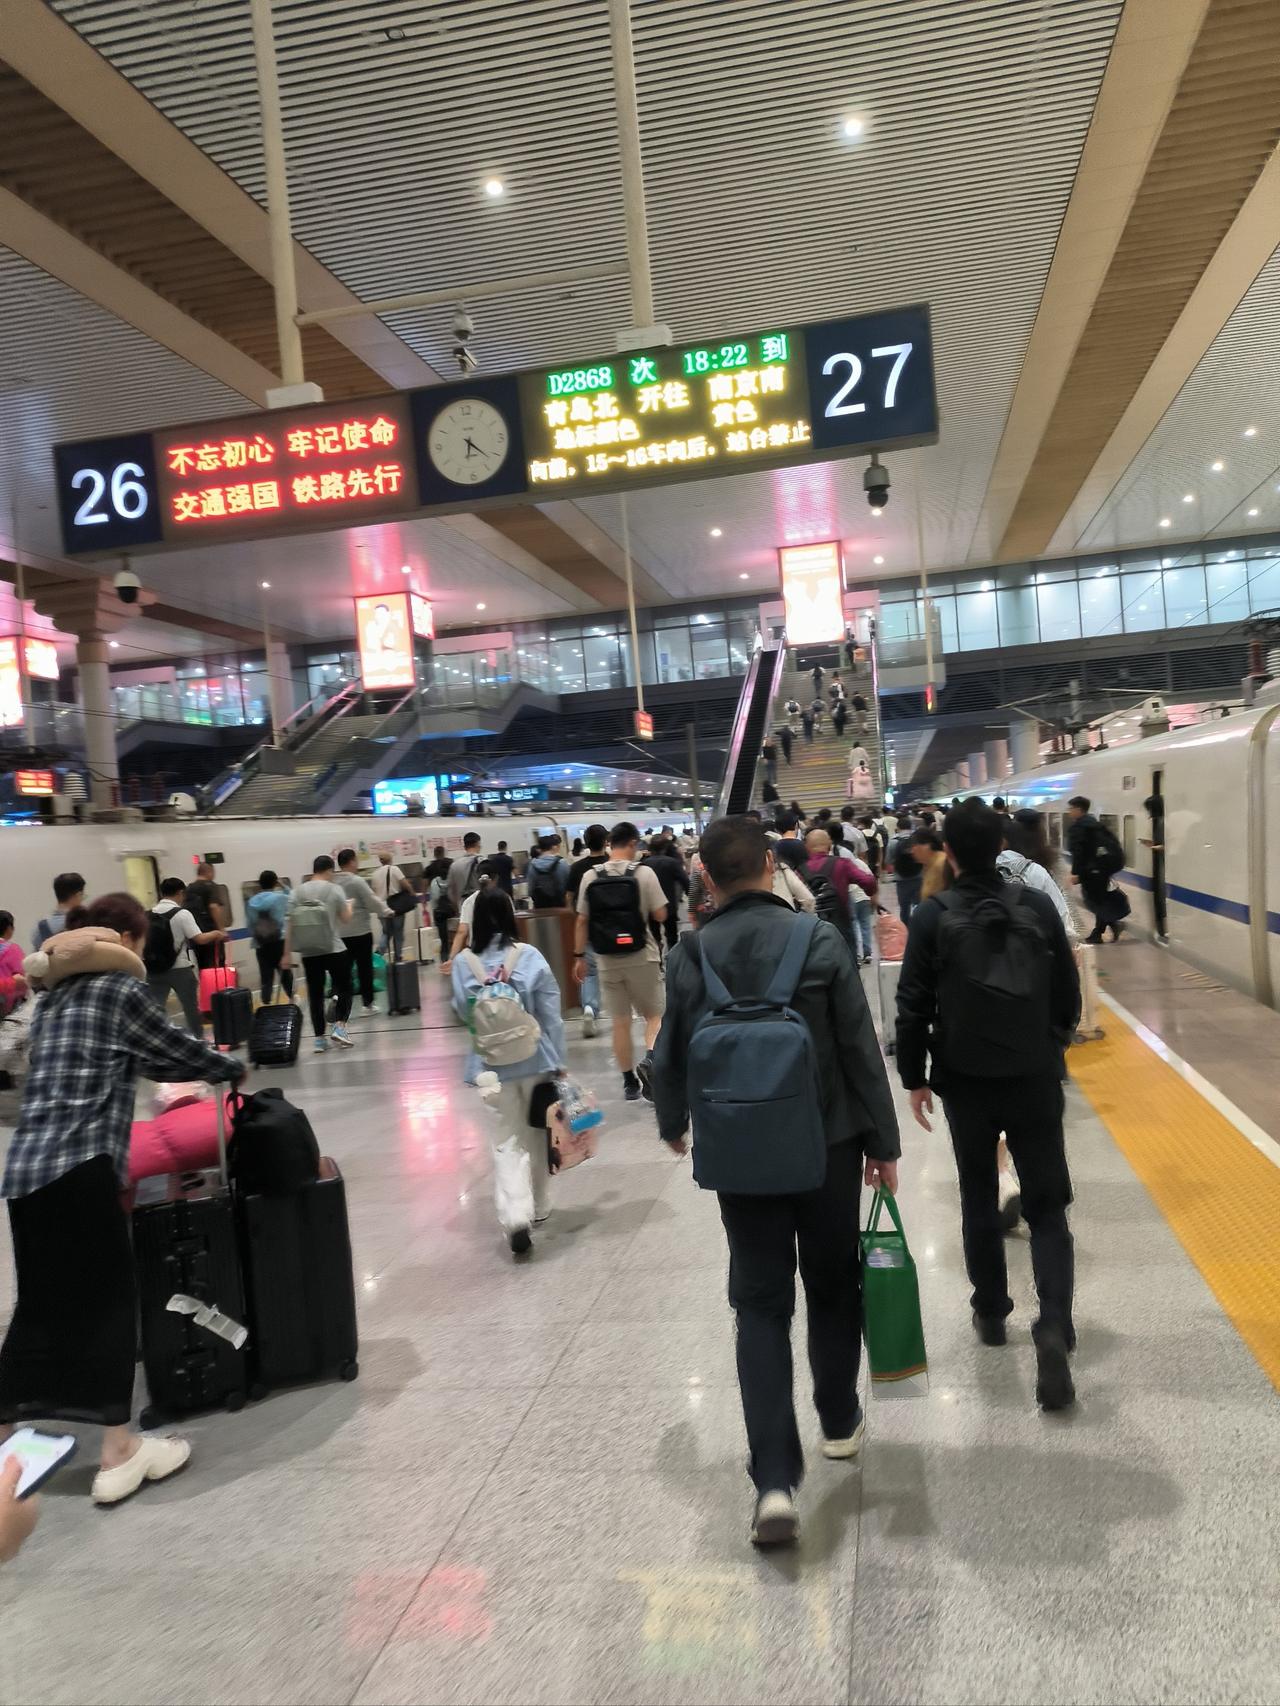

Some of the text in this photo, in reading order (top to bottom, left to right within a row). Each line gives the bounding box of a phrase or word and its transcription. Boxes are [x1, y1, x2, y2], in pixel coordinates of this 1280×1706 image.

[548, 334, 788, 395] D2868 次 18:22 到
[821, 342, 913, 418] 27
[544, 365, 786, 427] 青岛北 开往 南京南
[711, 400, 758, 428] 黄色
[168, 416, 396, 476] 不忘初心 牢记使命
[70, 461, 149, 526] 26
[173, 463, 402, 521] 交通强国 铁路先行
